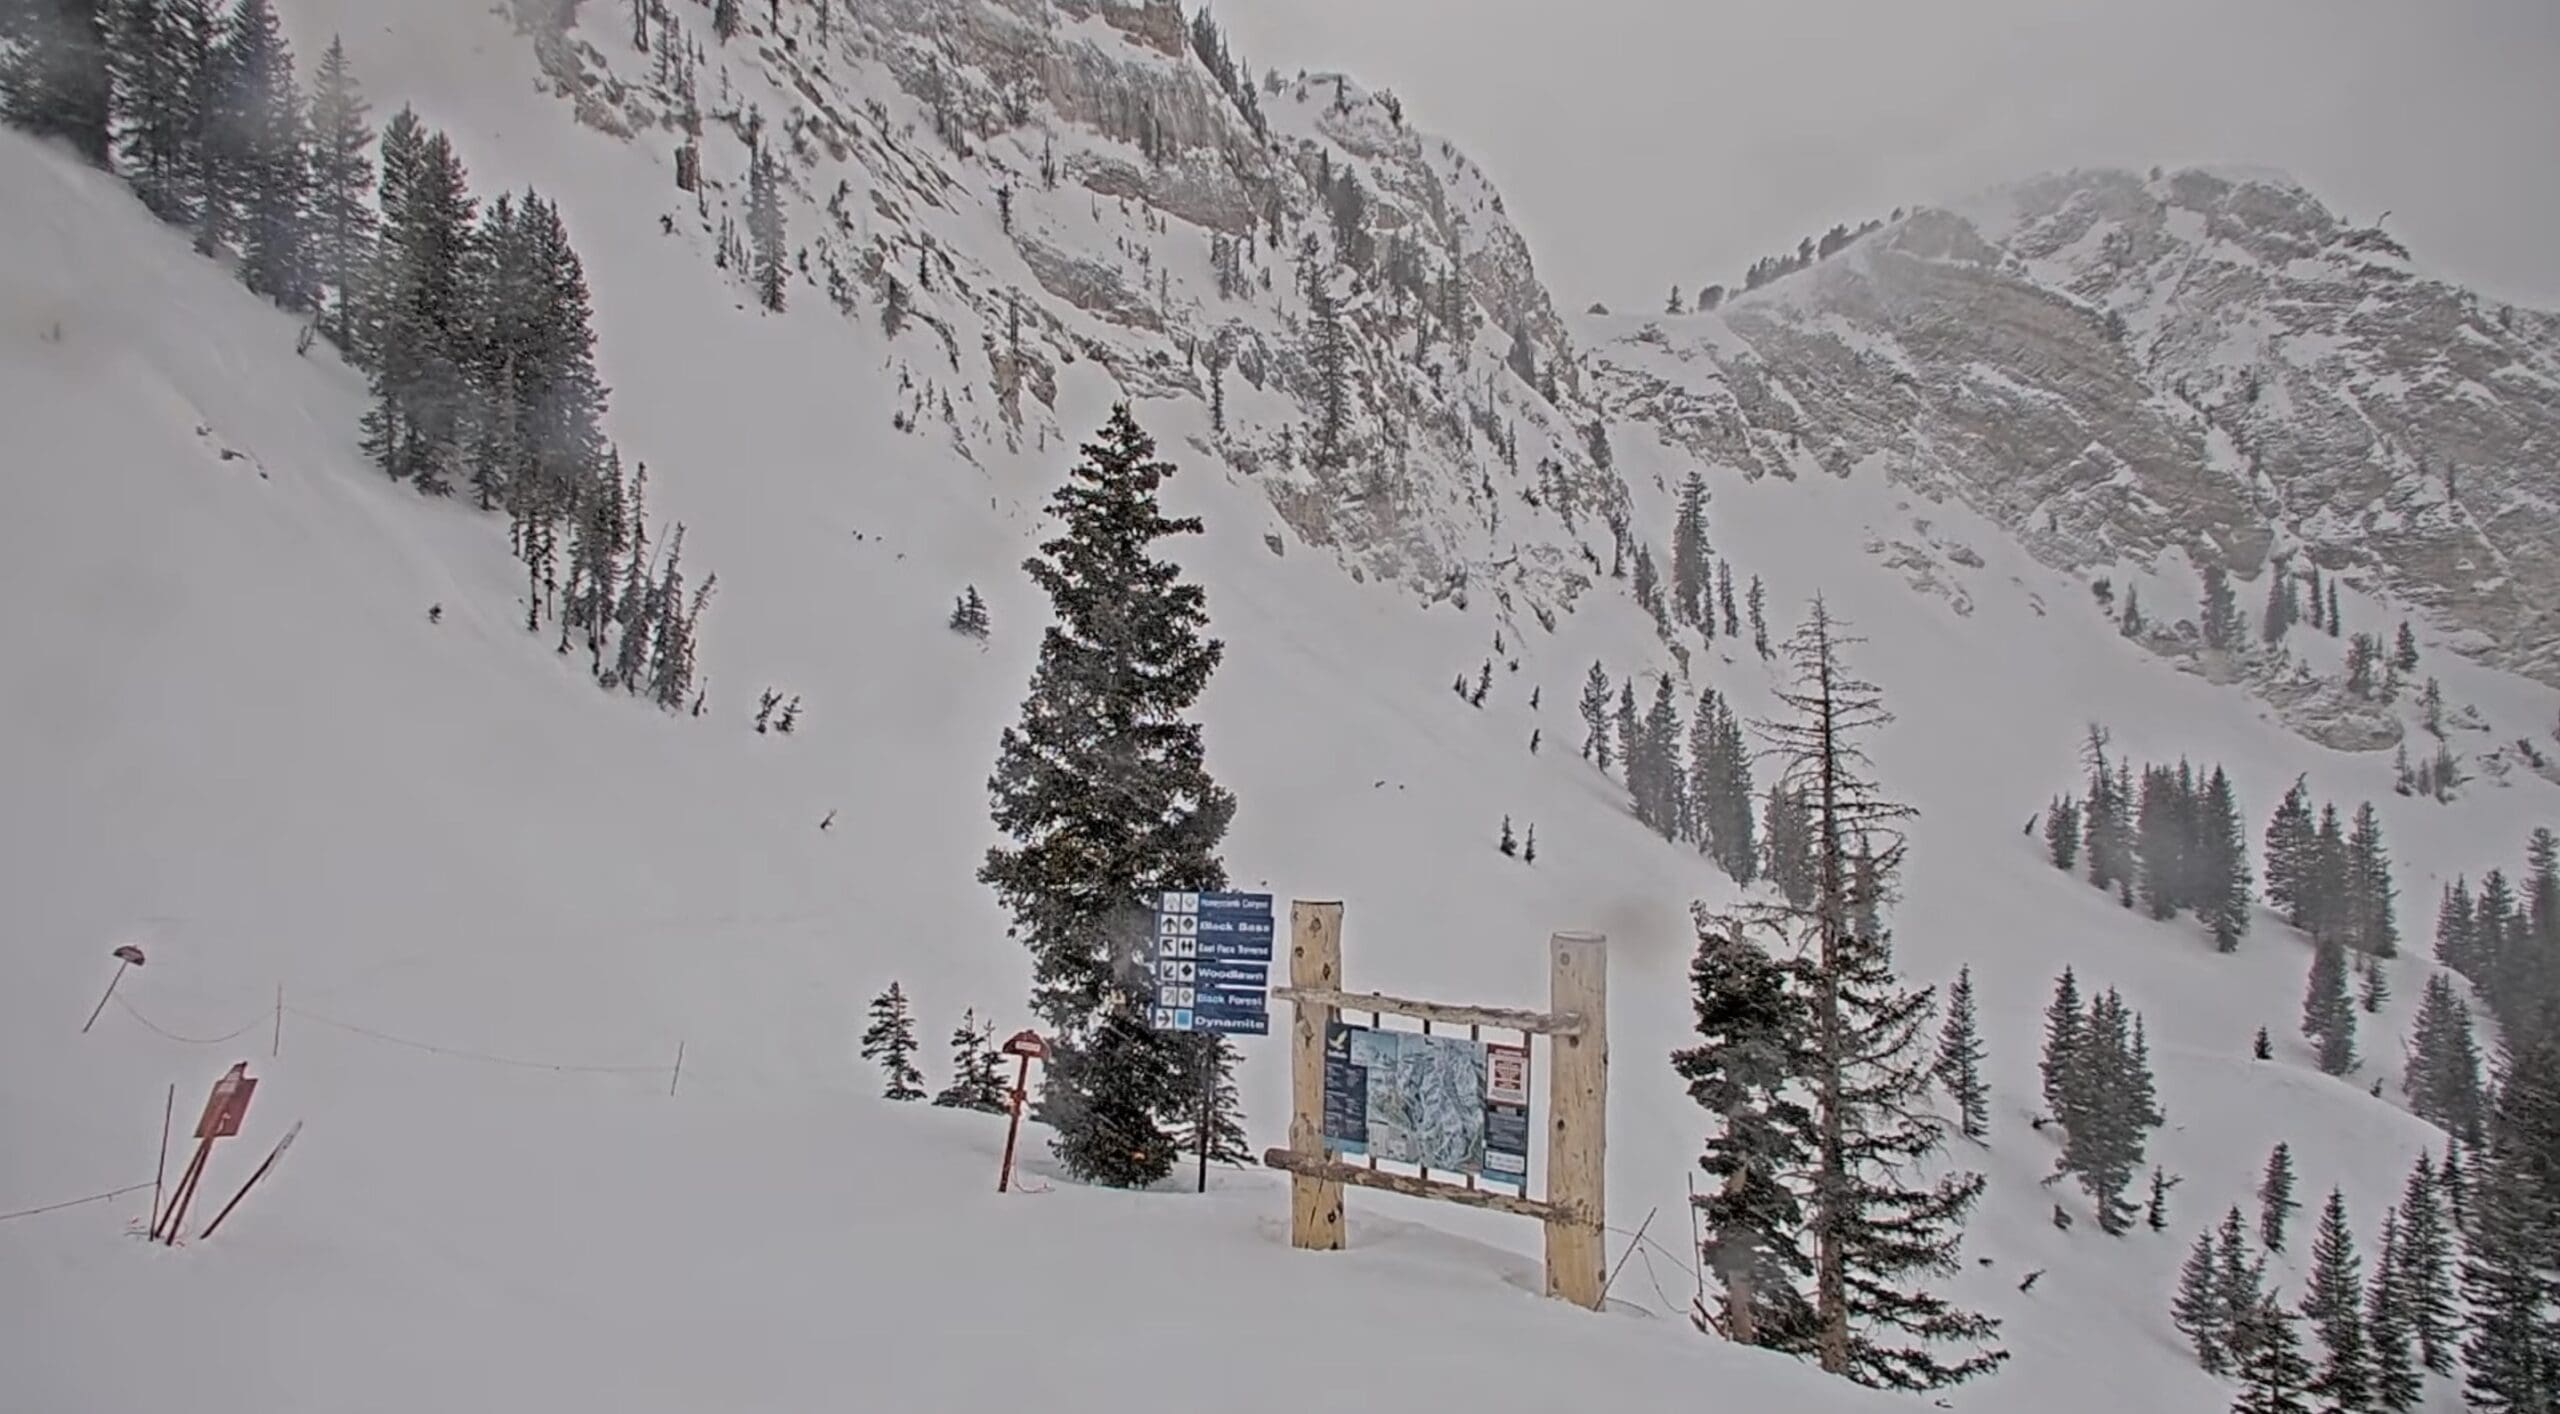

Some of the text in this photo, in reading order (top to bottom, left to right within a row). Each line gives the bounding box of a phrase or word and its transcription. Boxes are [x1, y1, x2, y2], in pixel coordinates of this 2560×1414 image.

[1217, 944, 1235, 954] Face
[1198, 968, 1264, 980] Woodlawn
[1197, 994, 1262, 1006] Black Forest
[1195, 1016, 1264, 1029] Dynamite
